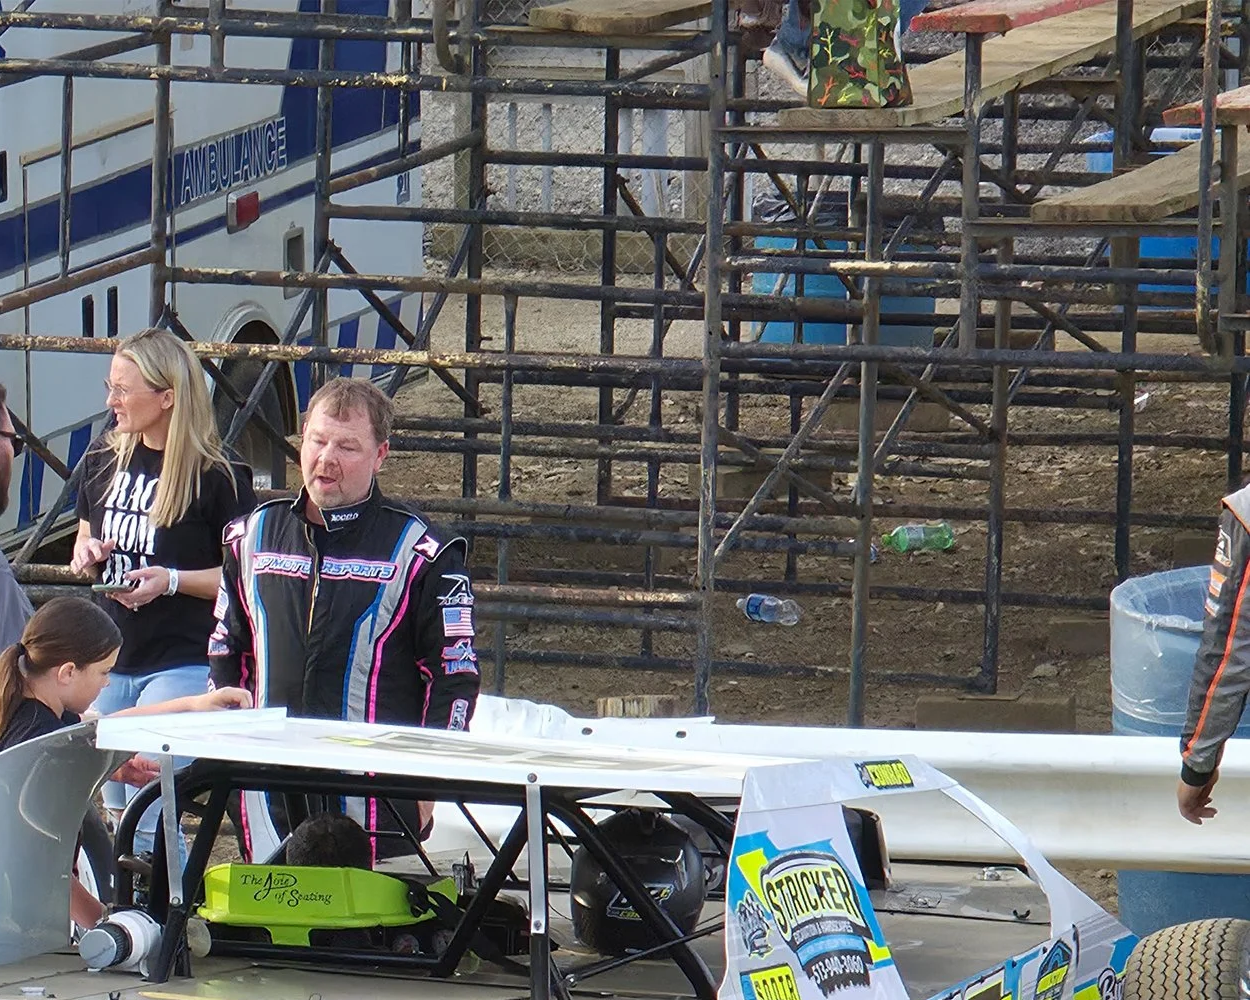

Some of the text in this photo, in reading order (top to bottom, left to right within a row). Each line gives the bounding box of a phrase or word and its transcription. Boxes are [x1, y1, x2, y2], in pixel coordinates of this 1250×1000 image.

[181, 116, 288, 205] AMBULANCE
[103, 471, 160, 514] RAC
[101, 509, 156, 556] MOM
[240, 873, 263, 886] The
[274, 888, 333, 908] of Seating
[764, 862, 860, 934] STRICKER
